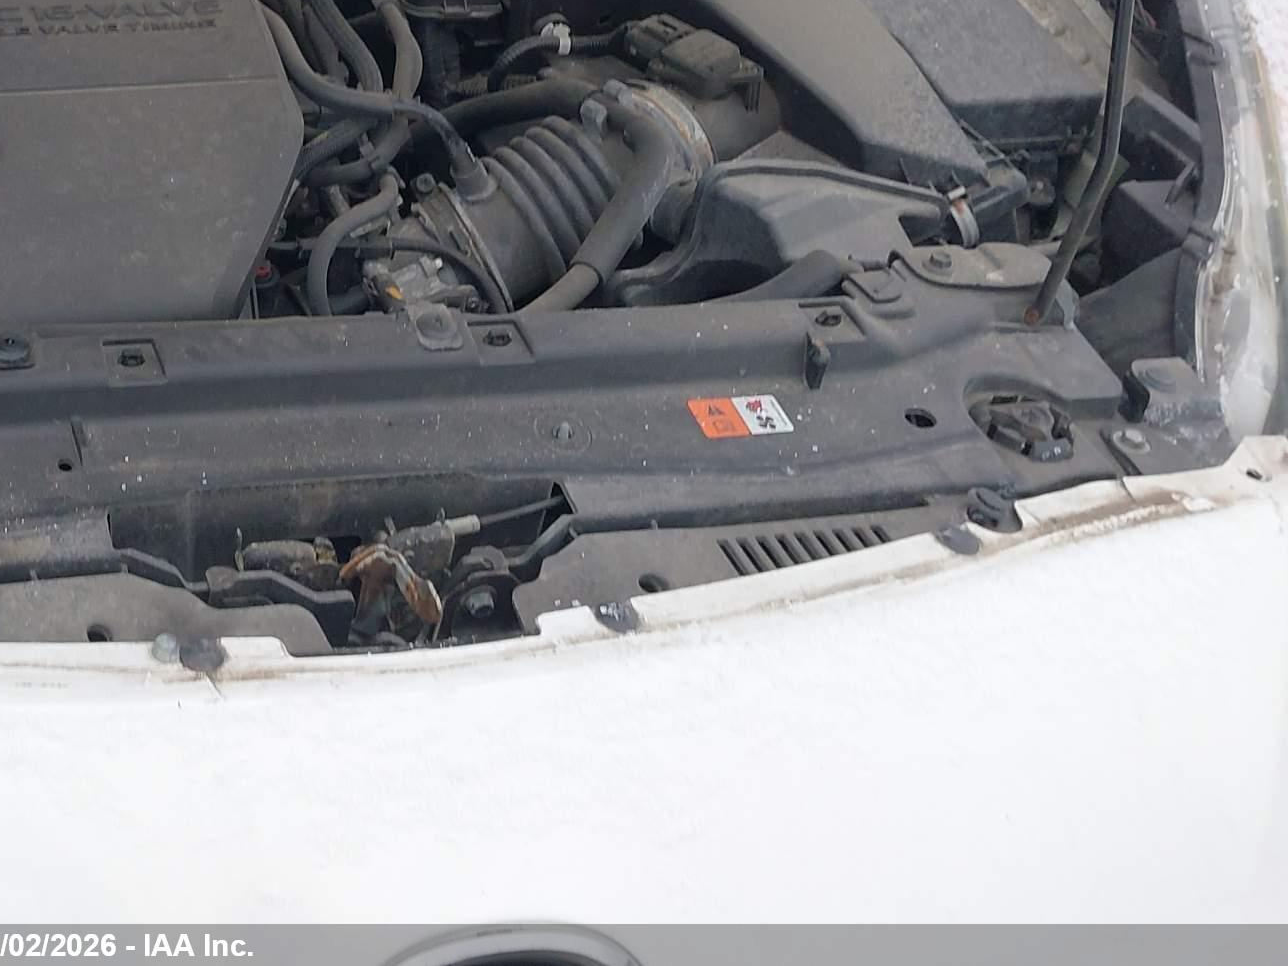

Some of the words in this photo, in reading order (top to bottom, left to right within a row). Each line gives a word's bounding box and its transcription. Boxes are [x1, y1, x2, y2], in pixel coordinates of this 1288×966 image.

[29, 0, 223, 22] 16-VALVE
[38, 23, 120, 35] VALVE
[125, 17, 217, 32] TIMING
